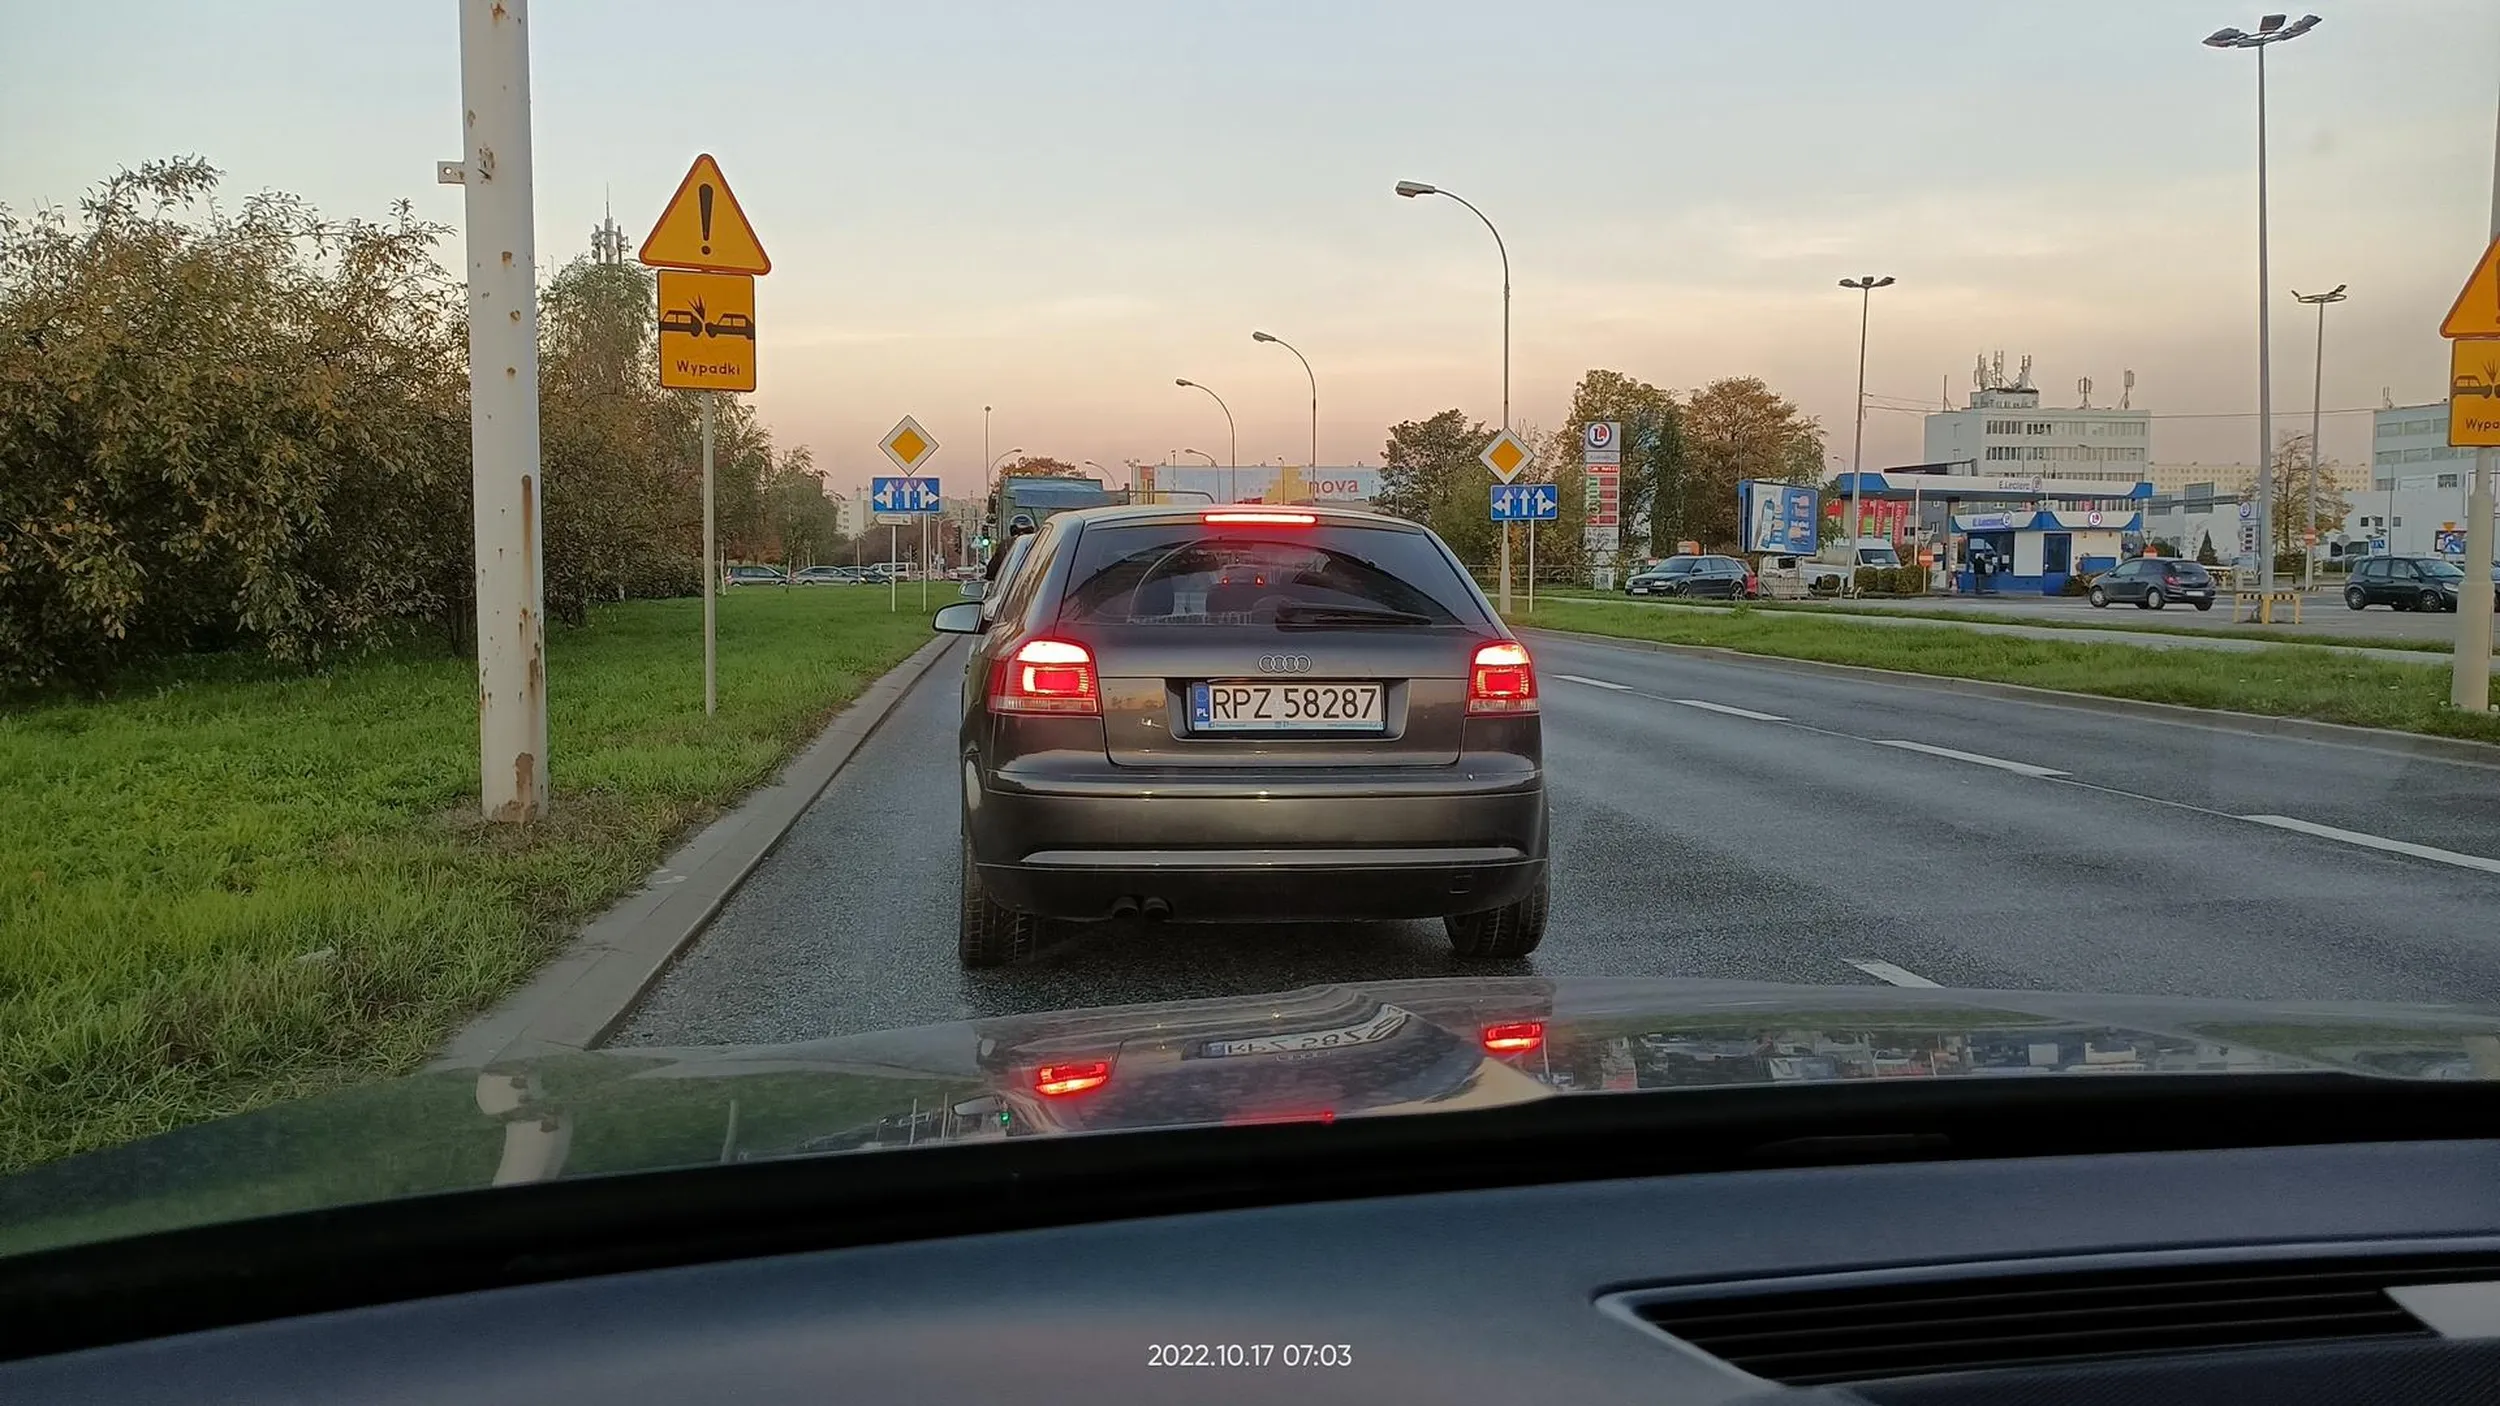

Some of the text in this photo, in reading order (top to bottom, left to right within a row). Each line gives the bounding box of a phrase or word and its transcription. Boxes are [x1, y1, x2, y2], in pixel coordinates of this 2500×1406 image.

[676, 360, 740, 376] Wypadki
[1307, 478, 1359, 495] nova
[1212, 688, 1377, 719] RPZ 58287
[1196, 708, 1209, 717] PL
